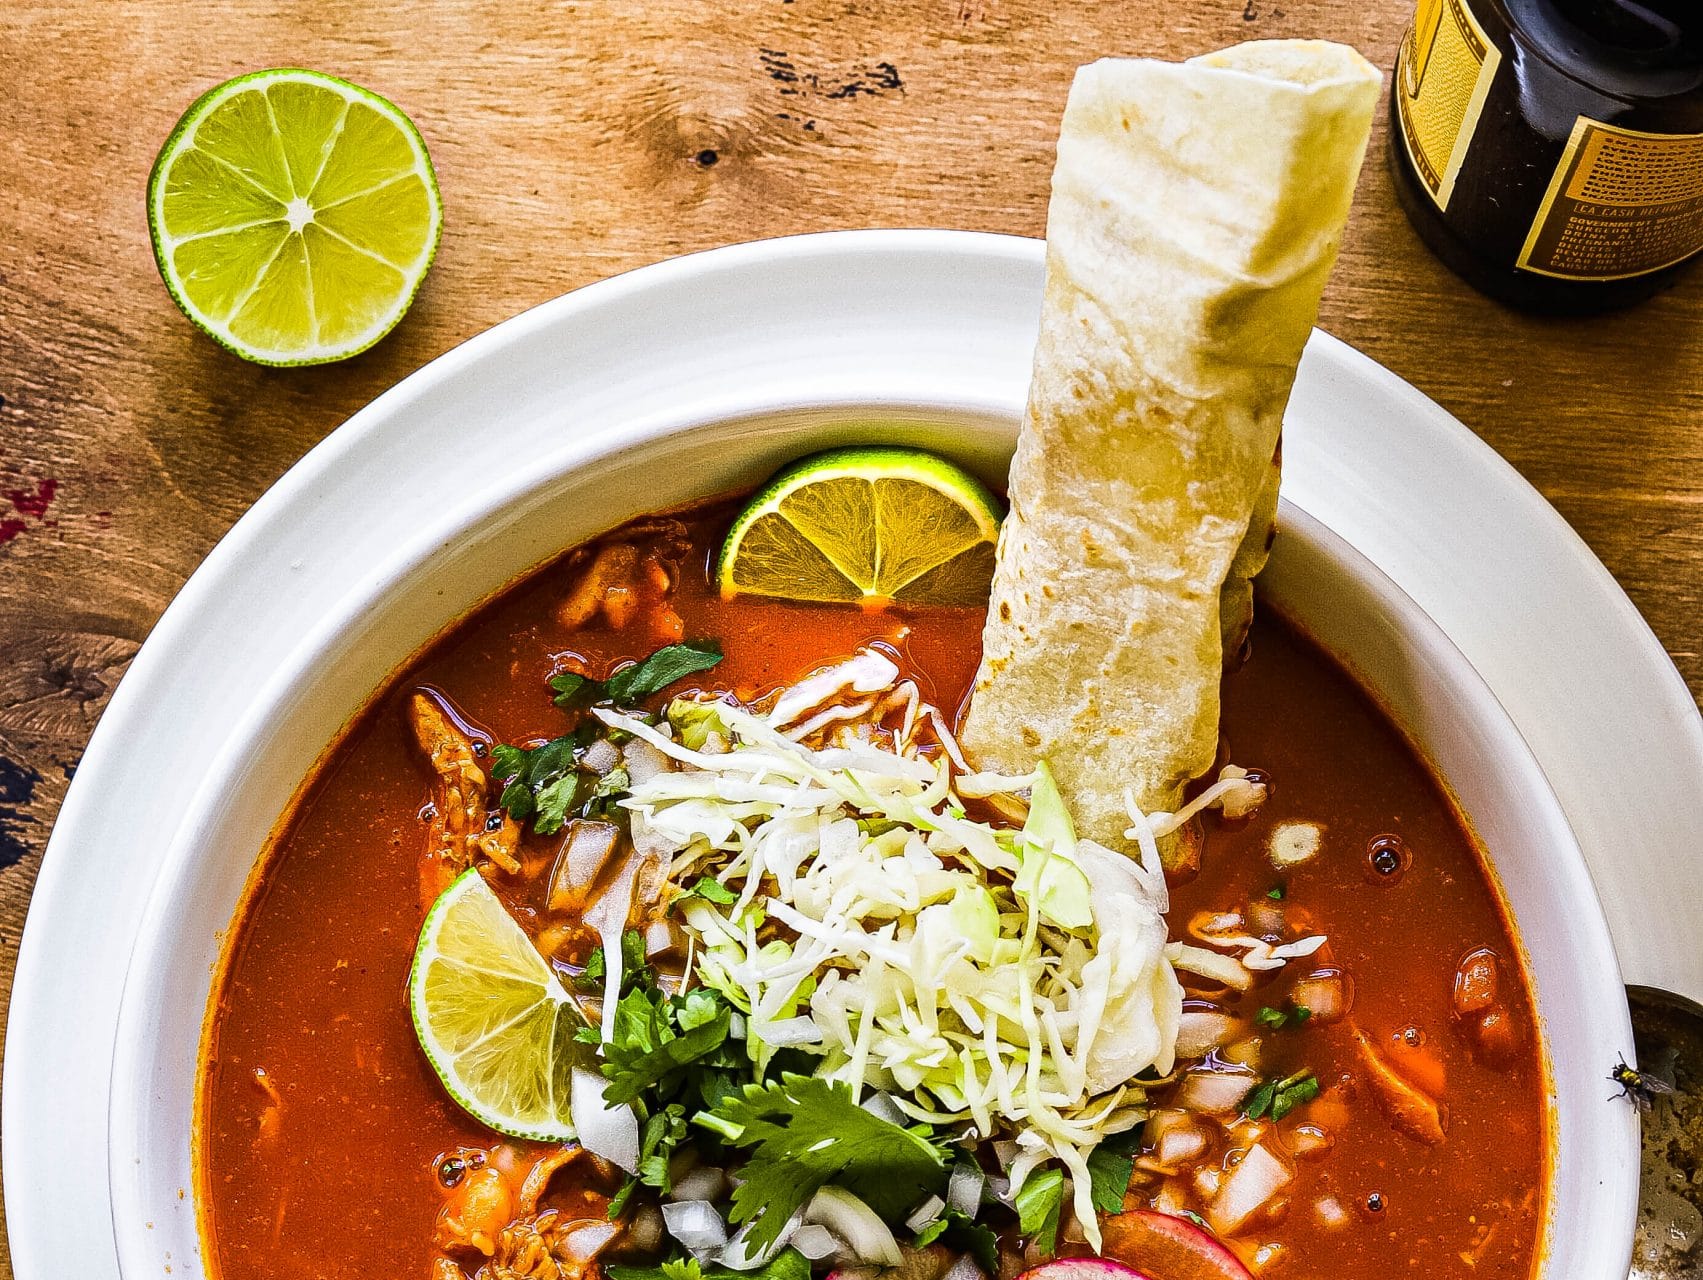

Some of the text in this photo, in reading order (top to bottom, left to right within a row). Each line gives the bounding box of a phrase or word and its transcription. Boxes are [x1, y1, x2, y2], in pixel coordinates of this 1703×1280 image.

[1605, 138, 1659, 150] SMALL
[1602, 145, 1645, 156] EVERY
[1594, 163, 1623, 172] OUR
[1597, 157, 1641, 168] LOCAL
[1589, 175, 1628, 184] BOCK
[1586, 181, 1650, 190] SLIGHTLY
[1583, 186, 1629, 196] ENJOY
[1580, 192, 1641, 202] ENJOYED
[1579, 204, 1595, 214] CA
[1569, 216, 1654, 228] GOVERNMENT
[1563, 229, 1607, 240] DRINK
